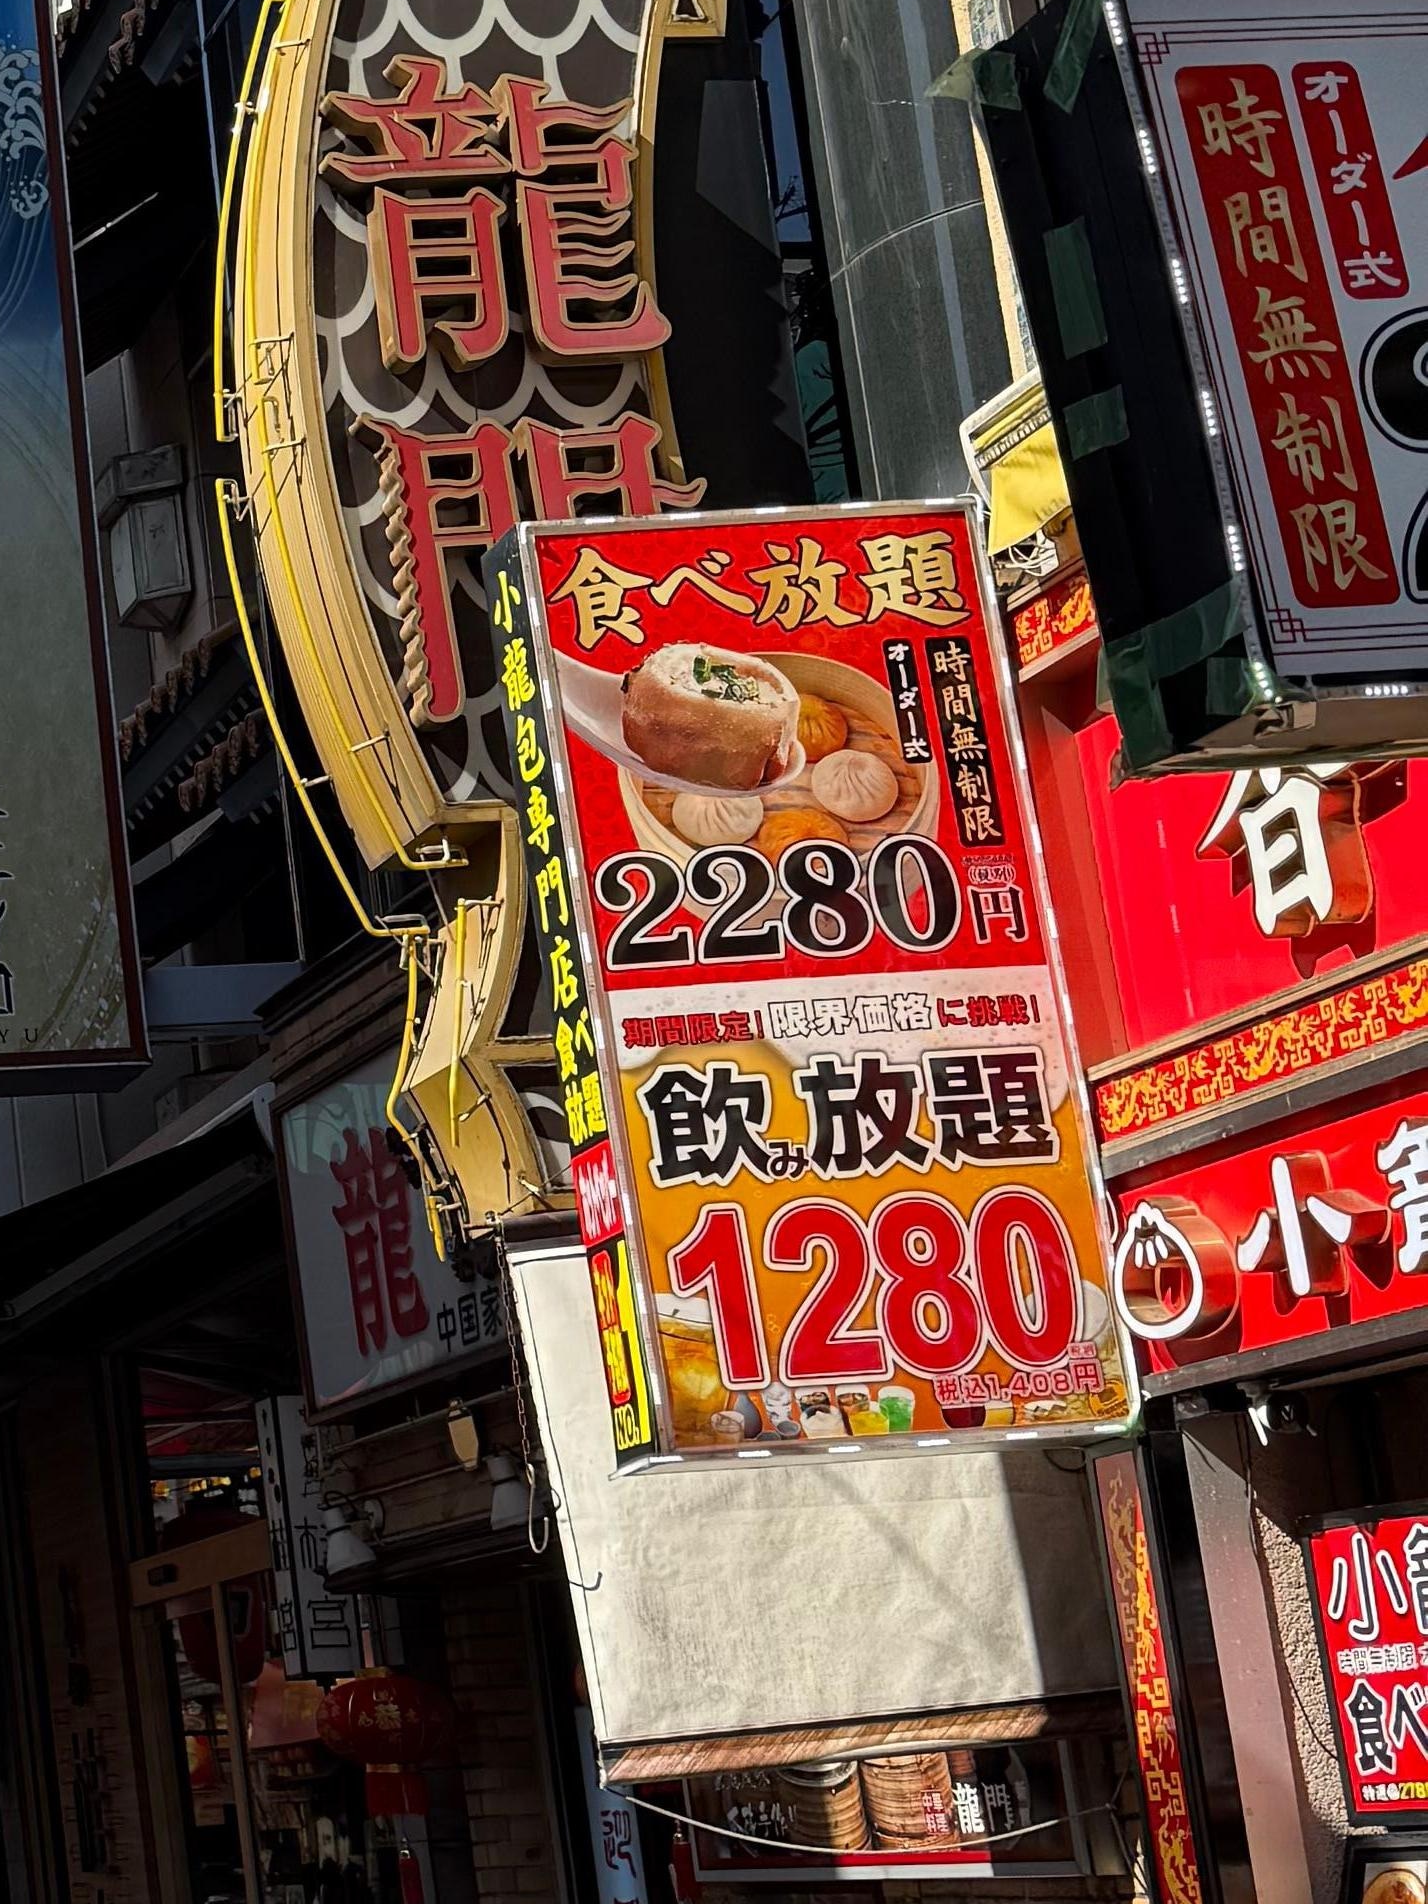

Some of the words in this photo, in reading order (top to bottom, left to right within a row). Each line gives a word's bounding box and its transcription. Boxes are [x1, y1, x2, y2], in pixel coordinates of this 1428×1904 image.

[1304, 69, 1403, 289] オーダー式
[1200, 77, 1392, 593] 時間無制限
[550, 530, 973, 651] 食べ放題
[887, 642, 931, 760] オーダー式
[933, 639, 1003, 844] 時間無制限
[594, 833, 964, 972] 2280
[967, 884, 1028, 945] 円
[623, 1010, 763, 1048] 期間限定!
[767, 992, 932, 1039] 限界価格
[936, 994, 1041, 1027] に挑戦!
[637, 1046, 1060, 1189] 飲み放題
[668, 1191, 1084, 1390] 1280
[932, 1357, 1104, 1406] 税込1,408円
